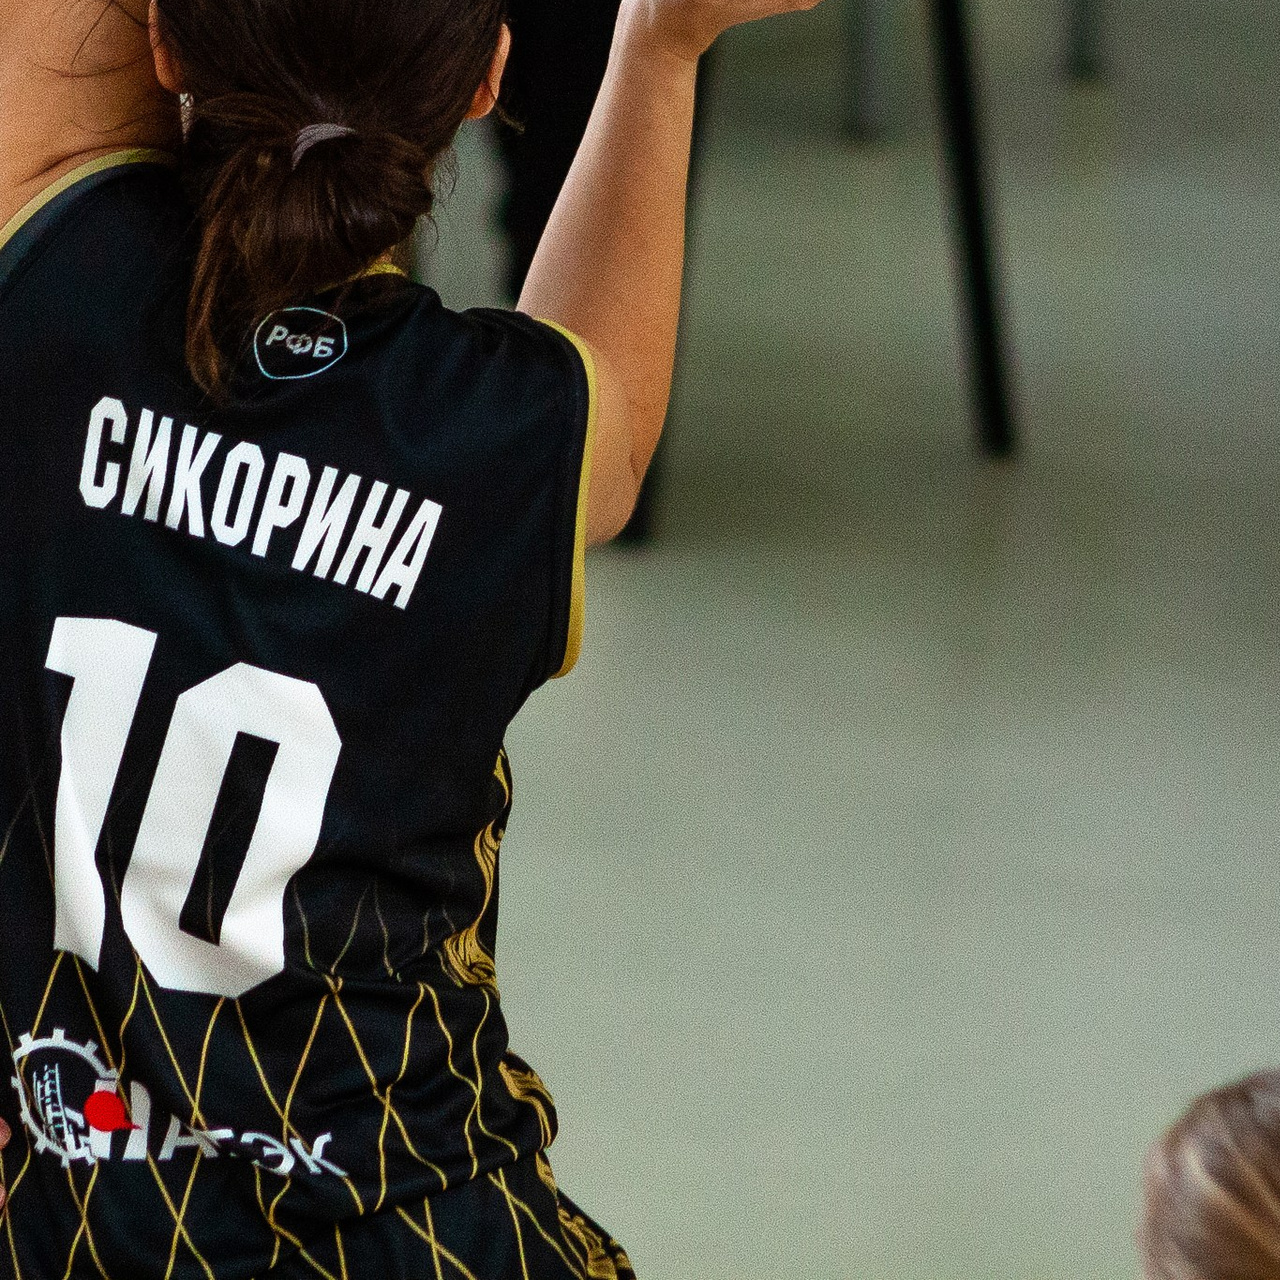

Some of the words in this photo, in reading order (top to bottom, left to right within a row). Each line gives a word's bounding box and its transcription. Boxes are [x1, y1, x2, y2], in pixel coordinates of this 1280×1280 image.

[265, 325, 335, 358] РФБ
[78, 396, 443, 610] СИКОРИНА
[45, 616, 343, 999] 10
